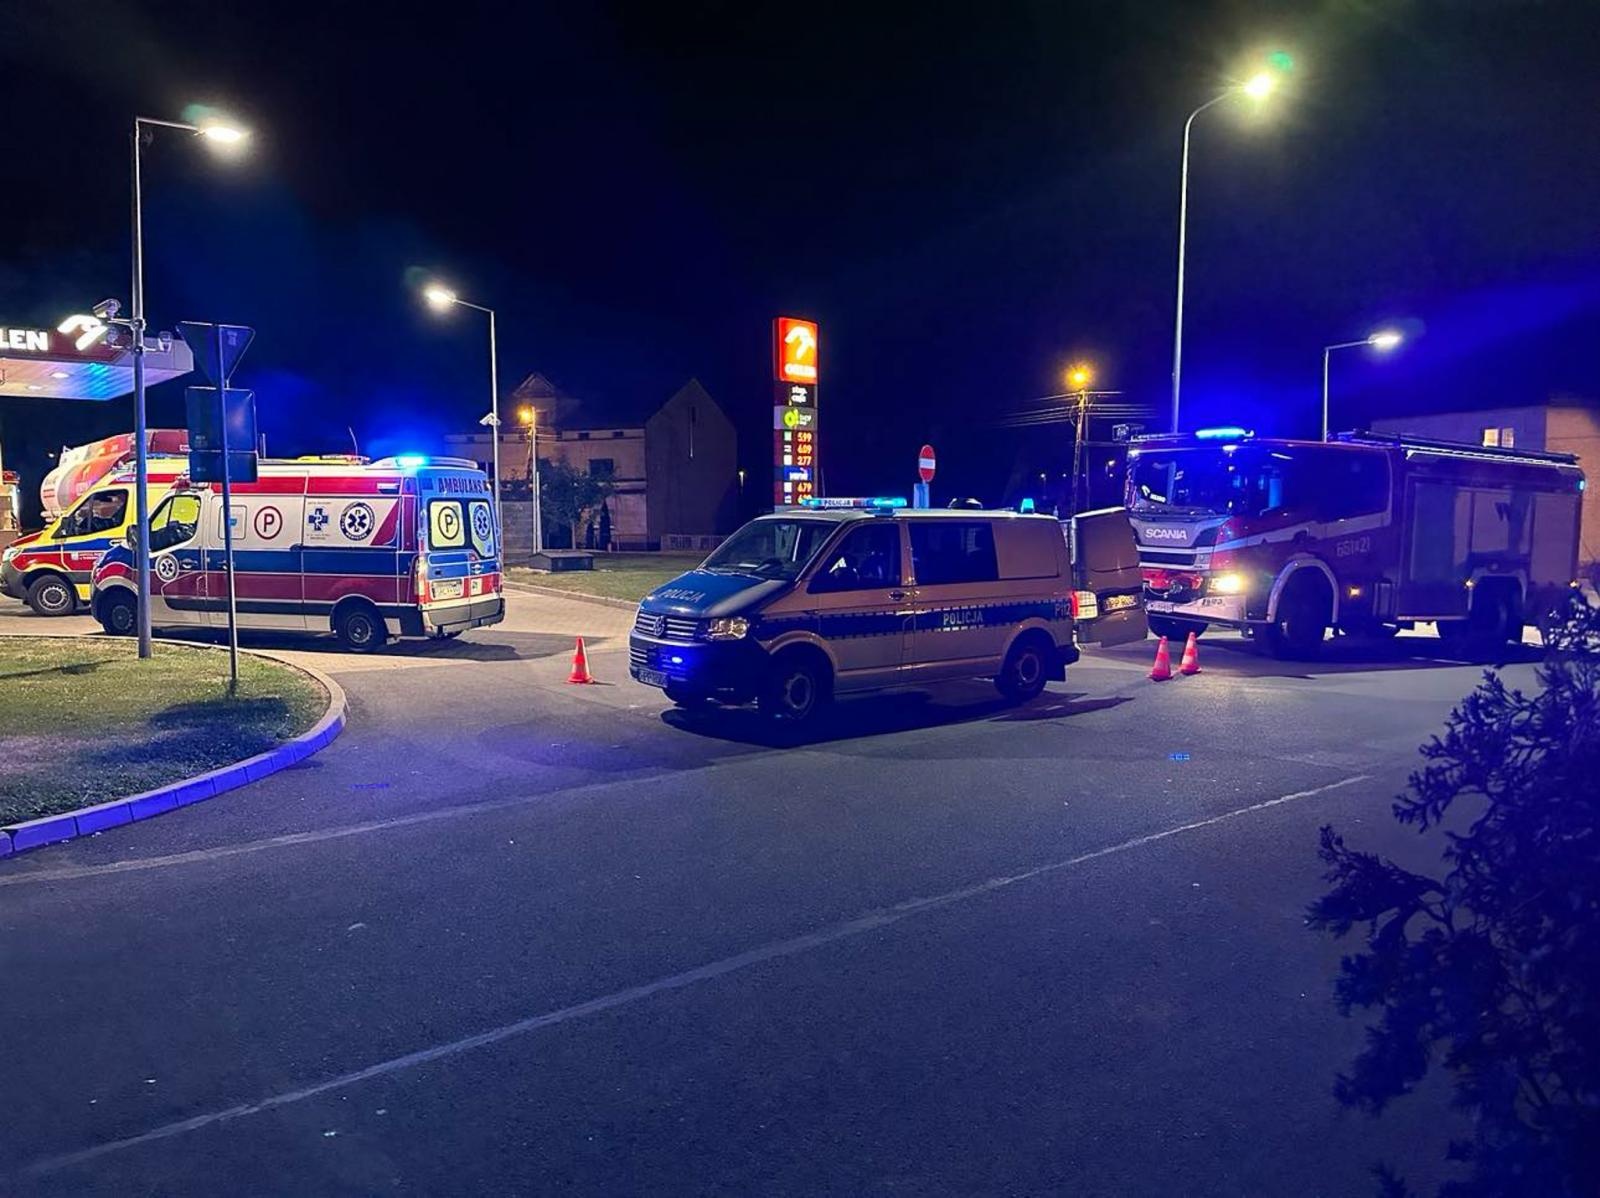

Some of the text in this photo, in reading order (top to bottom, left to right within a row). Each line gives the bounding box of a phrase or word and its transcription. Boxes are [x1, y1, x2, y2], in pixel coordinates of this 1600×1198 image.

[1145, 528, 1188, 541] SCANIA
[657, 588, 707, 604] POLICJA
[942, 610, 984, 626] POLICJA
